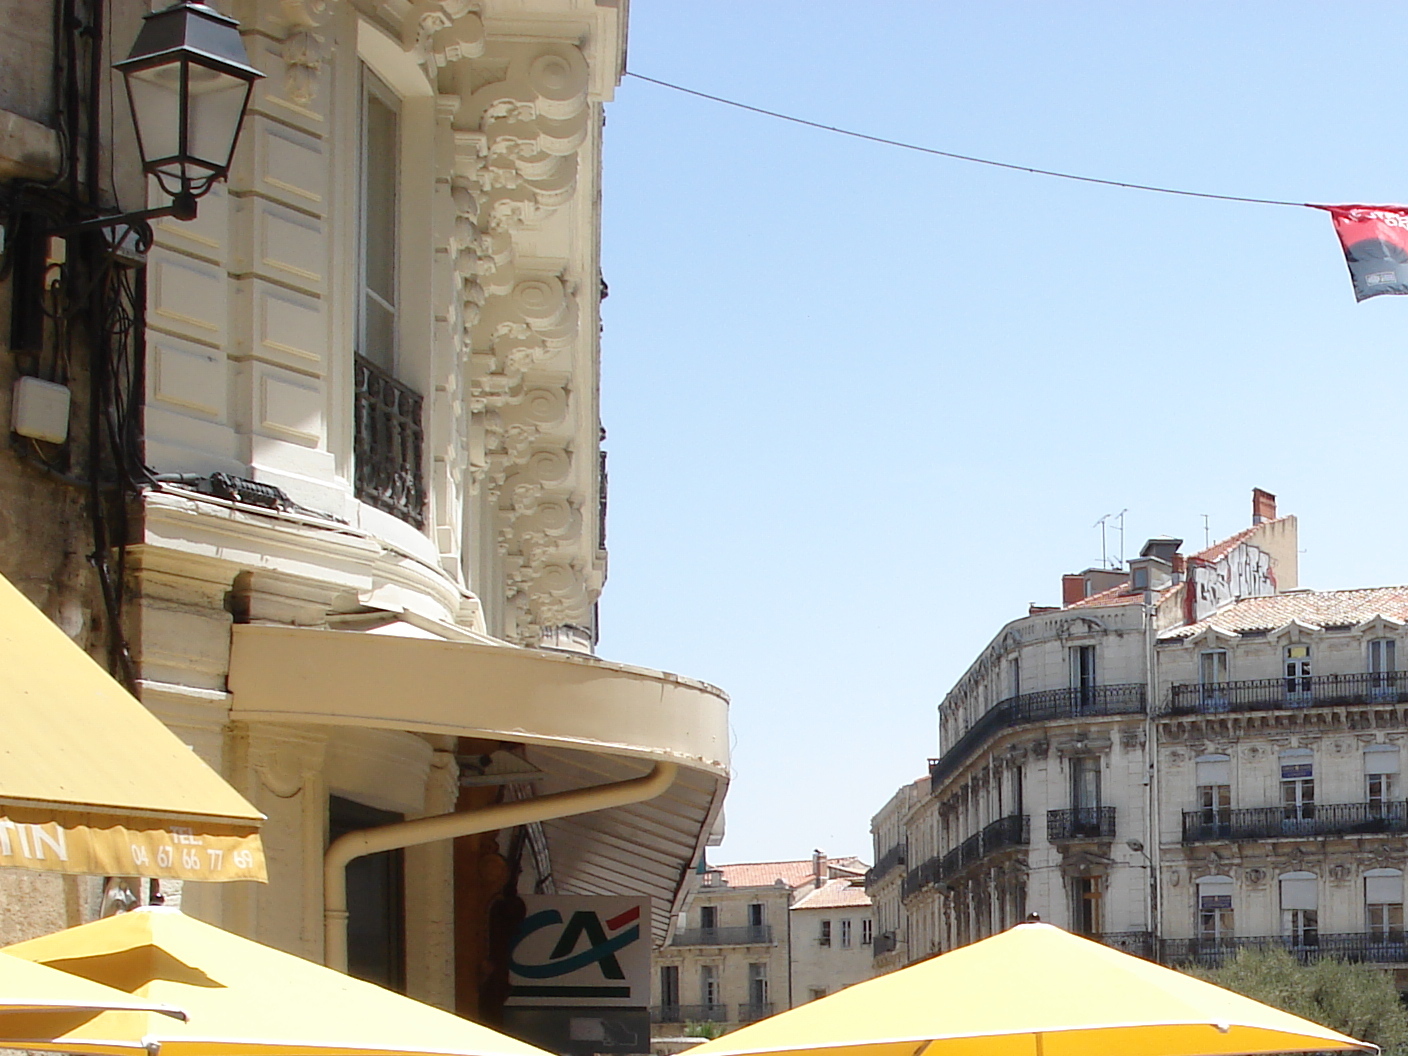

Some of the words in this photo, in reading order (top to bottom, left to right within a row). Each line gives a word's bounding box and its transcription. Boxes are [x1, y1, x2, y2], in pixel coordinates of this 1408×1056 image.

[130, 843, 150, 867] 04
[157, 845, 174, 868] 67
[182, 848, 201, 870] 66
[206, 849, 224, 871] 77
[232, 849, 254, 869] 69
